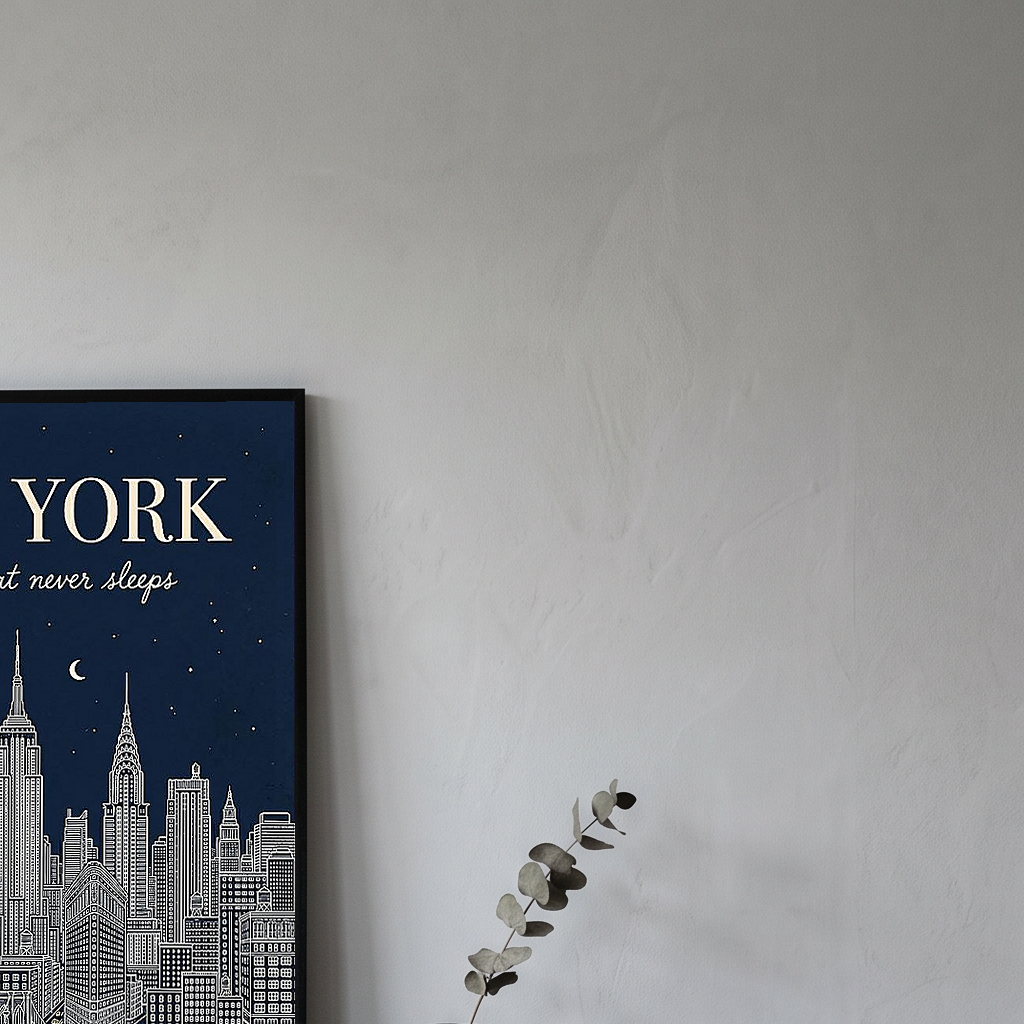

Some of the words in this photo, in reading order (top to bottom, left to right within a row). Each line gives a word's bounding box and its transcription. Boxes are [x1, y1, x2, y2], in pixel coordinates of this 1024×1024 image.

[10, 476, 233, 544] YORK
[28, 572, 94, 590] never
[100, 560, 179, 605] sleeps
